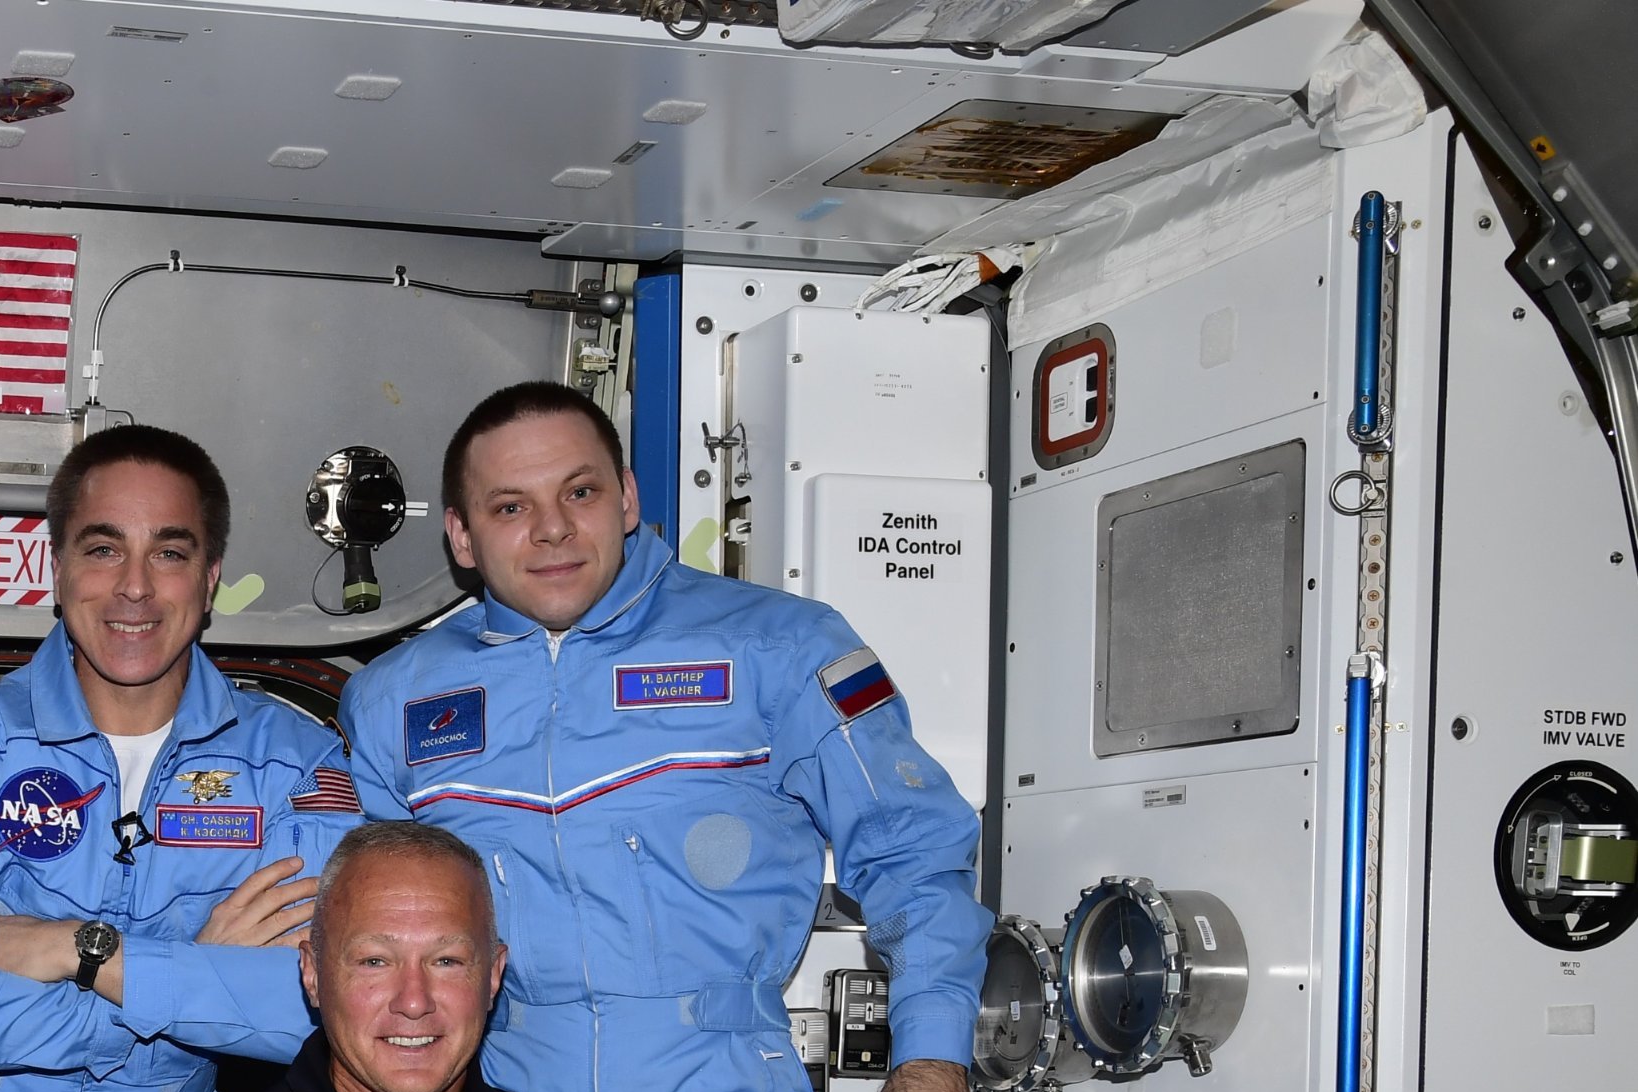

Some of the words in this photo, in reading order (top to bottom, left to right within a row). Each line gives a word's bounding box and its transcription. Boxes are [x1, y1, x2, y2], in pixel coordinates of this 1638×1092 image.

[882, 512, 938, 530] Zenith
[858, 537, 890, 553] IDA
[896, 538, 961, 556] Control
[885, 562, 934, 579] Panel
[656, 672, 705, 684] ВАГНЕР
[653, 685, 702, 697] VAGNER
[1543, 709, 1587, 725] STDB
[1591, 711, 1627, 727] FWD
[420, 732, 468, 749] РОСКОСМОС
[1543, 730, 1572, 746] IMV
[1575, 731, 1626, 748] VALVE
[0, 799, 82, 830] NASA
[202, 816, 249, 826] CASSIDY
[824, 902, 837, 921] 2
